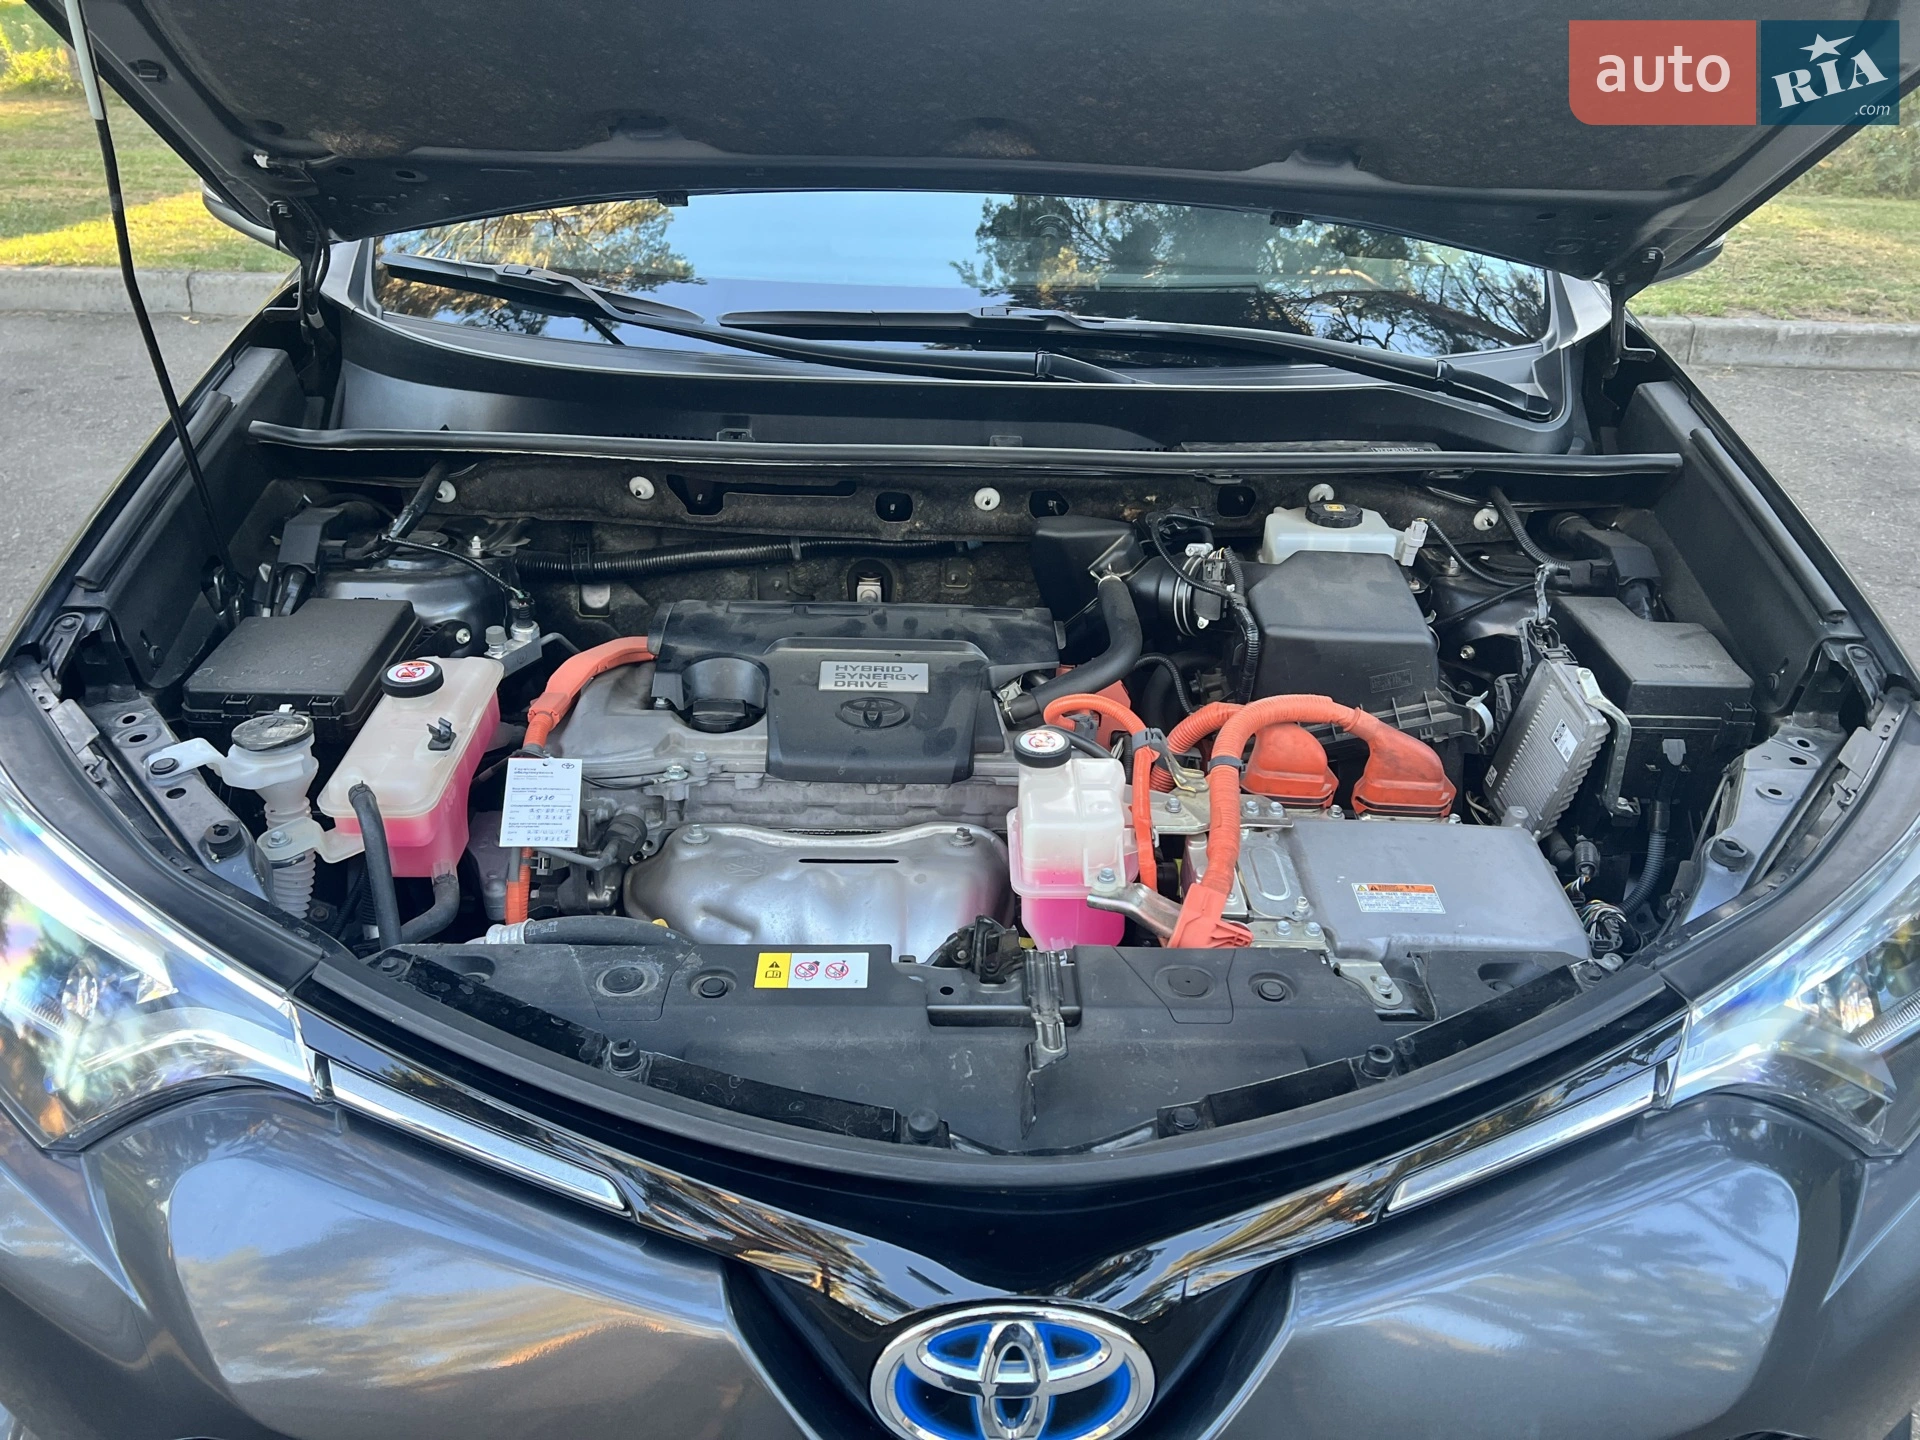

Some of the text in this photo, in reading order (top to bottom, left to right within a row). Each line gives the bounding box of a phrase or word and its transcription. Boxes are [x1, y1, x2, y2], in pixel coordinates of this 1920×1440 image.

[835, 664, 903, 673] HYBRID
[834, 672, 919, 681] SYNERGY
[834, 680, 889, 689] DRIVE
